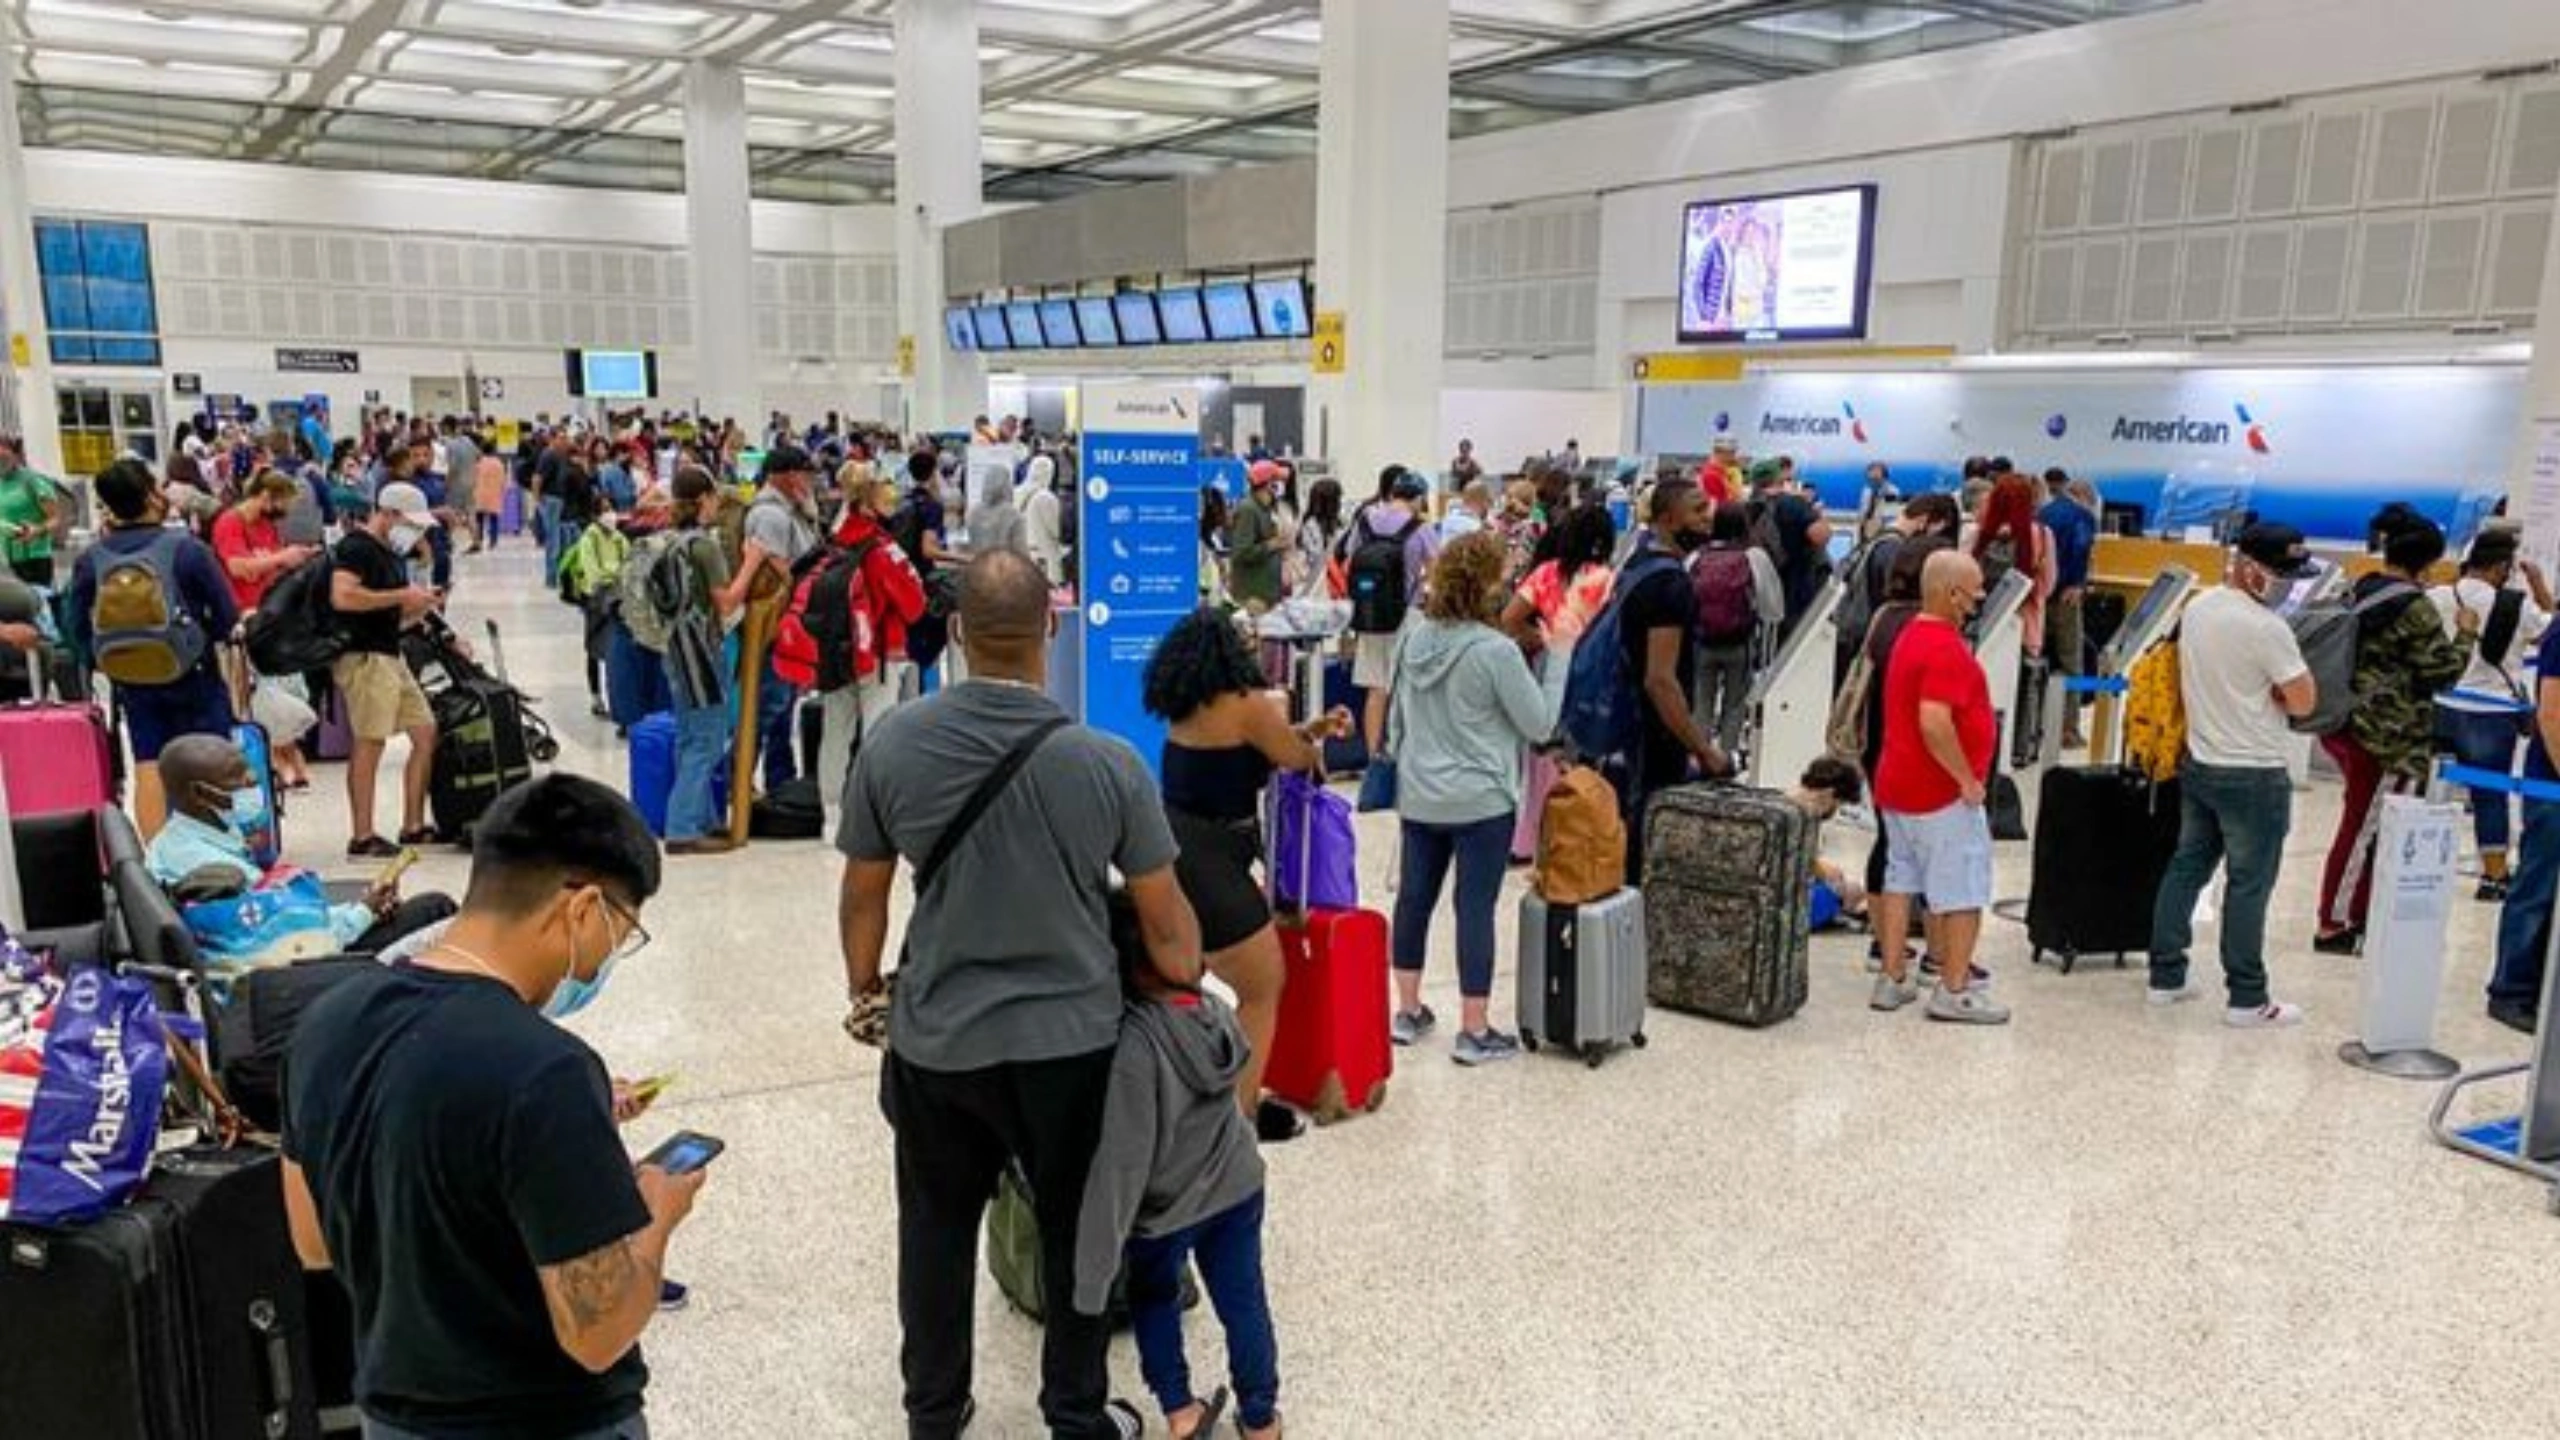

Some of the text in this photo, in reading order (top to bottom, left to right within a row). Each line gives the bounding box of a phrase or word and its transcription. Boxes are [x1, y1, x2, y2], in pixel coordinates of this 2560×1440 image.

[1759, 411, 1840, 435] American
[2111, 414, 2229, 444] American
[1092, 449, 1188, 465] SELF-SERVICE
[60, 1008, 132, 1192] Marshall
